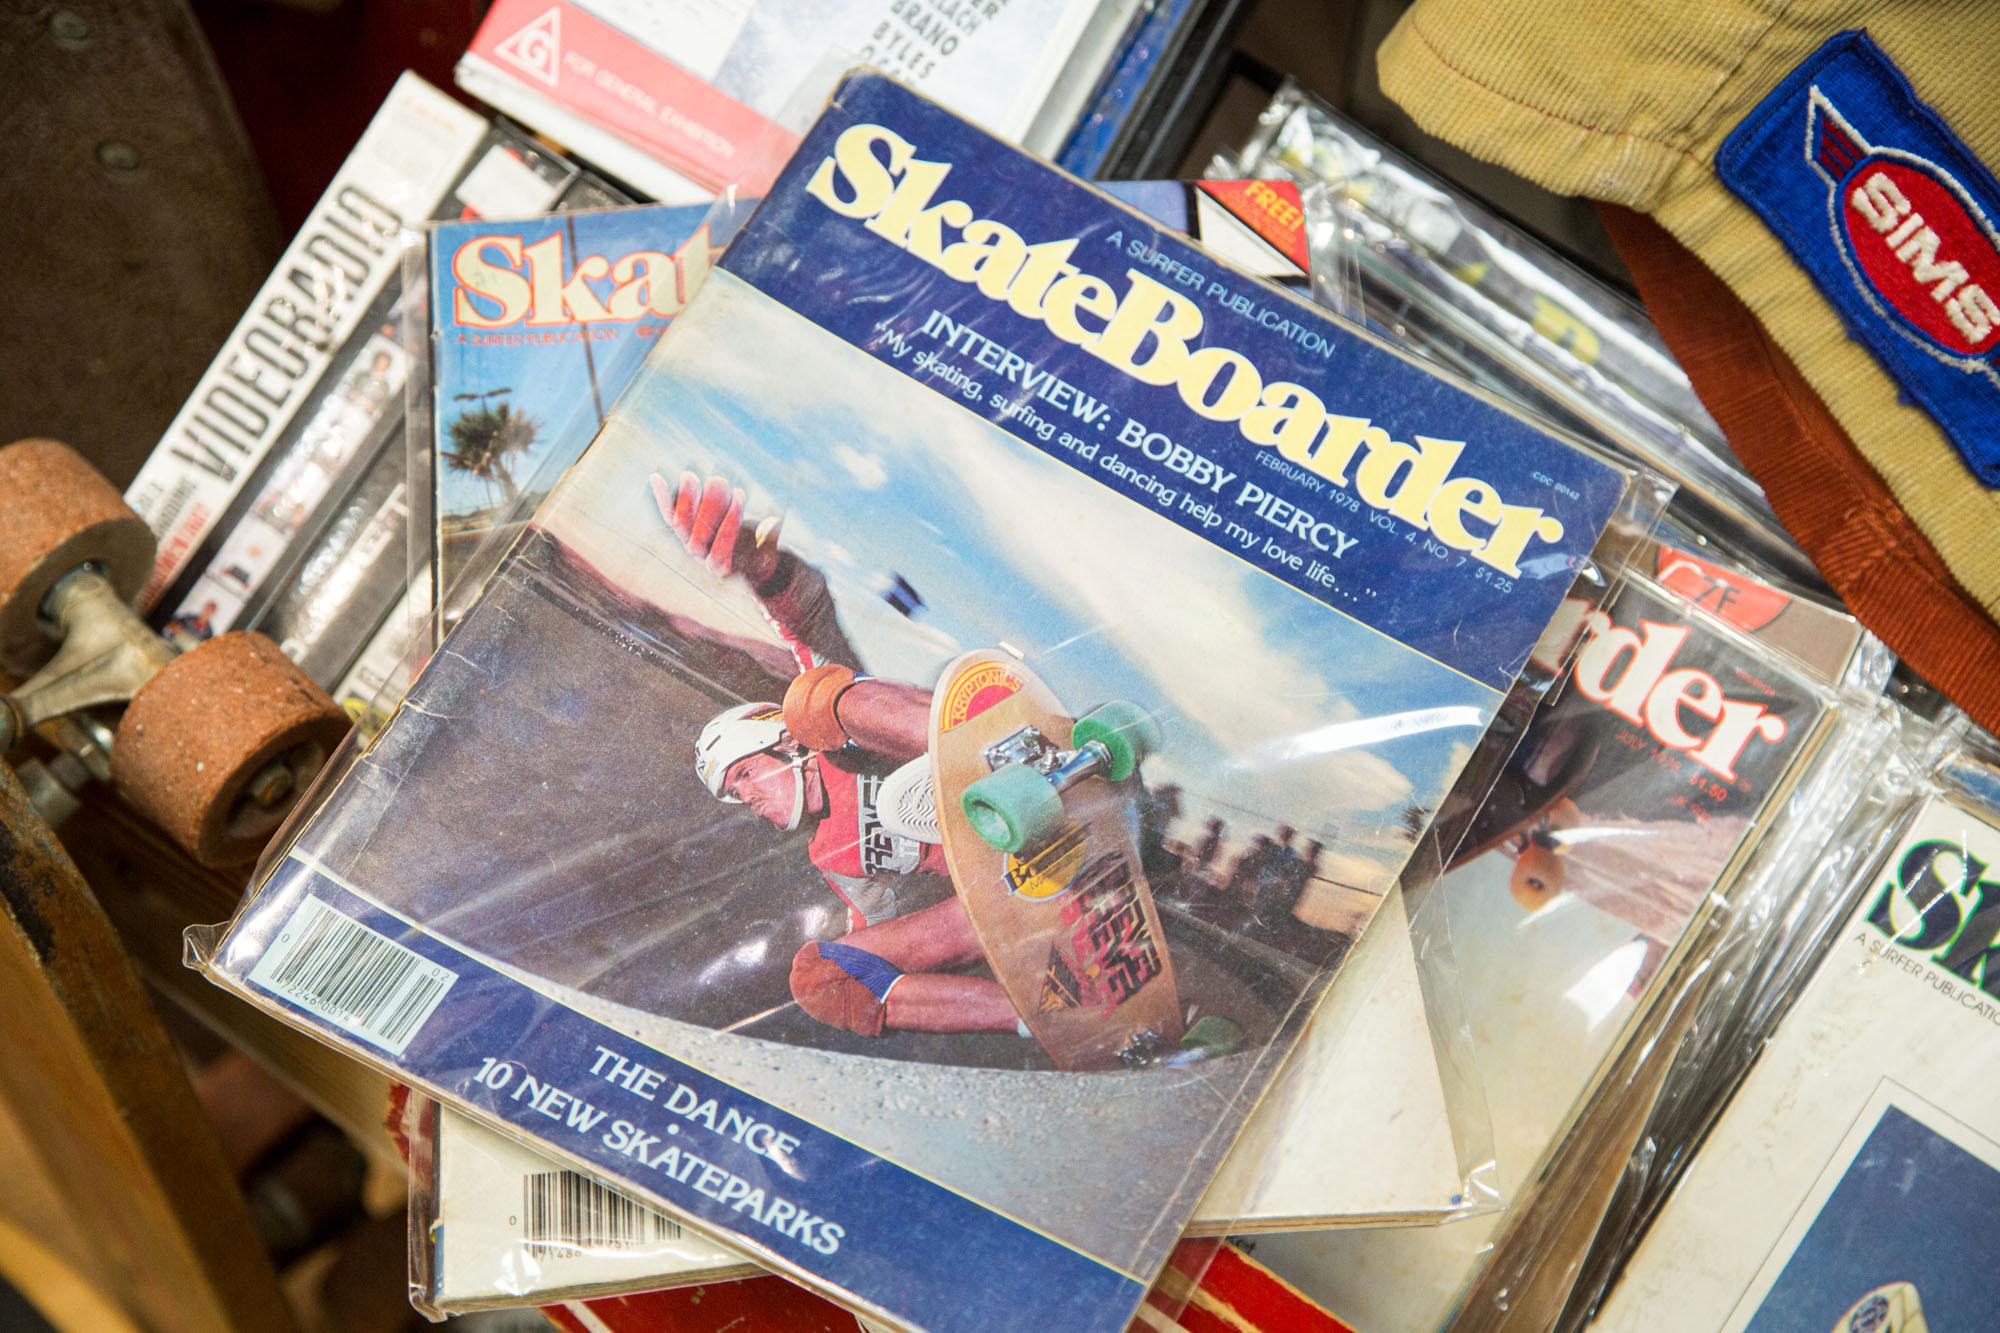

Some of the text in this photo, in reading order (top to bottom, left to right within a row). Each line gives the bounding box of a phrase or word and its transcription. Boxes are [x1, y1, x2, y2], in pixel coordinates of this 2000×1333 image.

[517, 29, 550, 68] G
[563, 51, 737, 159] FOR GENERAL EXHIBITION
[1244, 181, 1304, 232] FREE!
[1106, 230, 1337, 360] A SURFER PUBLICATION
[1851, 171, 2000, 345] SIMS
[456, 327, 619, 347] A SURFER PUBLICATION
[805, 122, 1565, 580] SkateBoarder
[912, 348, 983, 401] skating,
[989, 391, 1056, 441] surfing
[1058, 431, 1101, 462] and
[1100, 449, 1177, 508] dancing
[1179, 491, 1223, 529] help
[1224, 520, 1262, 549] my
[1261, 536, 1304, 571] love
[920, 309, 1360, 560] INTERVIEW: BOBBY PIERCY
[1255, 449, 1326, 493] FEBRUARY
[1328, 488, 1361, 513] 1978
[1369, 508, 1400, 536] VOL.
[1423, 538, 1450, 563] NO.
[1455, 556, 1468, 569] 7
[1475, 566, 1514, 594] $1.25
[950, 669, 1024, 726] KRYPTONICS
[1614, 728, 1649, 751] JULY
[1689, 771, 1728, 802] $1.50
[281, 933, 290, 944] 0
[1854, 932, 1868, 947] A
[1869, 939, 1924, 978] SURFER
[588, 1045, 802, 1161] THE DANCE
[473, 1056, 847, 1257] 10 NEW SKATEPARKS
[509, 1215, 517, 1227] 0
